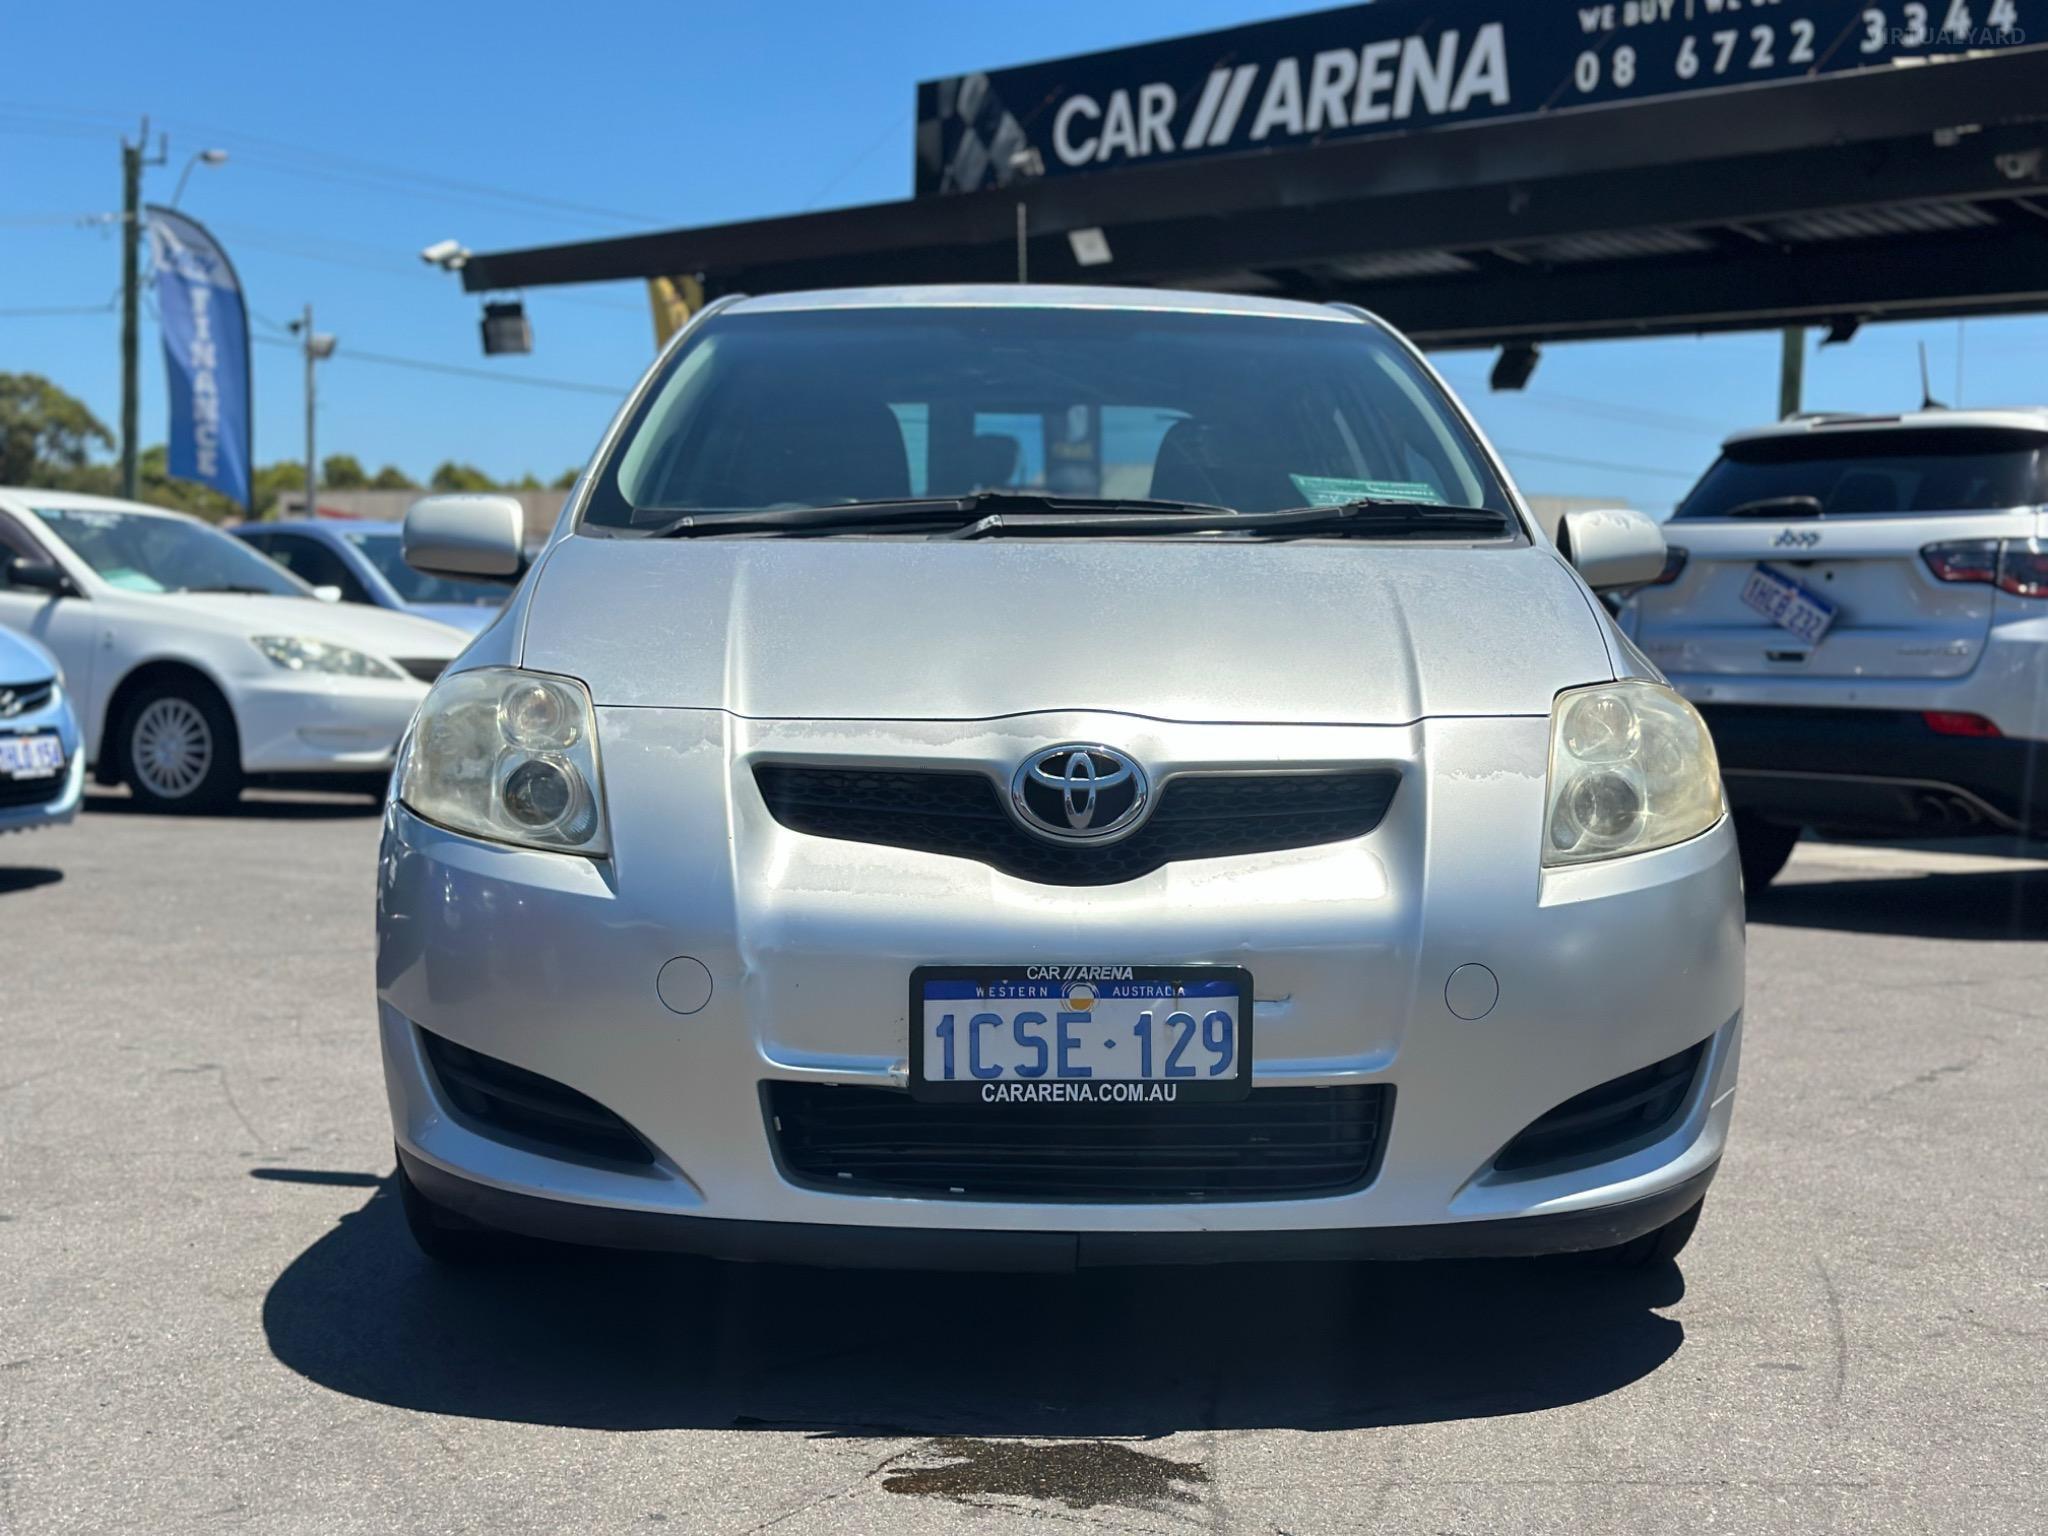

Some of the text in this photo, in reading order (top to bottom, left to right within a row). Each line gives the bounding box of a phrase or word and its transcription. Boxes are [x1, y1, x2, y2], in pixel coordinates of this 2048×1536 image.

[1578, 4, 1615, 34] WE
[1623, 0, 1674, 27] BUY
[1574, 0, 2018, 93] 08 6722 3344
[975, 985, 1186, 998] WESTERN AUSTRALIA
[981, 1083, 1178, 1103] CARARENA.COM.AU
